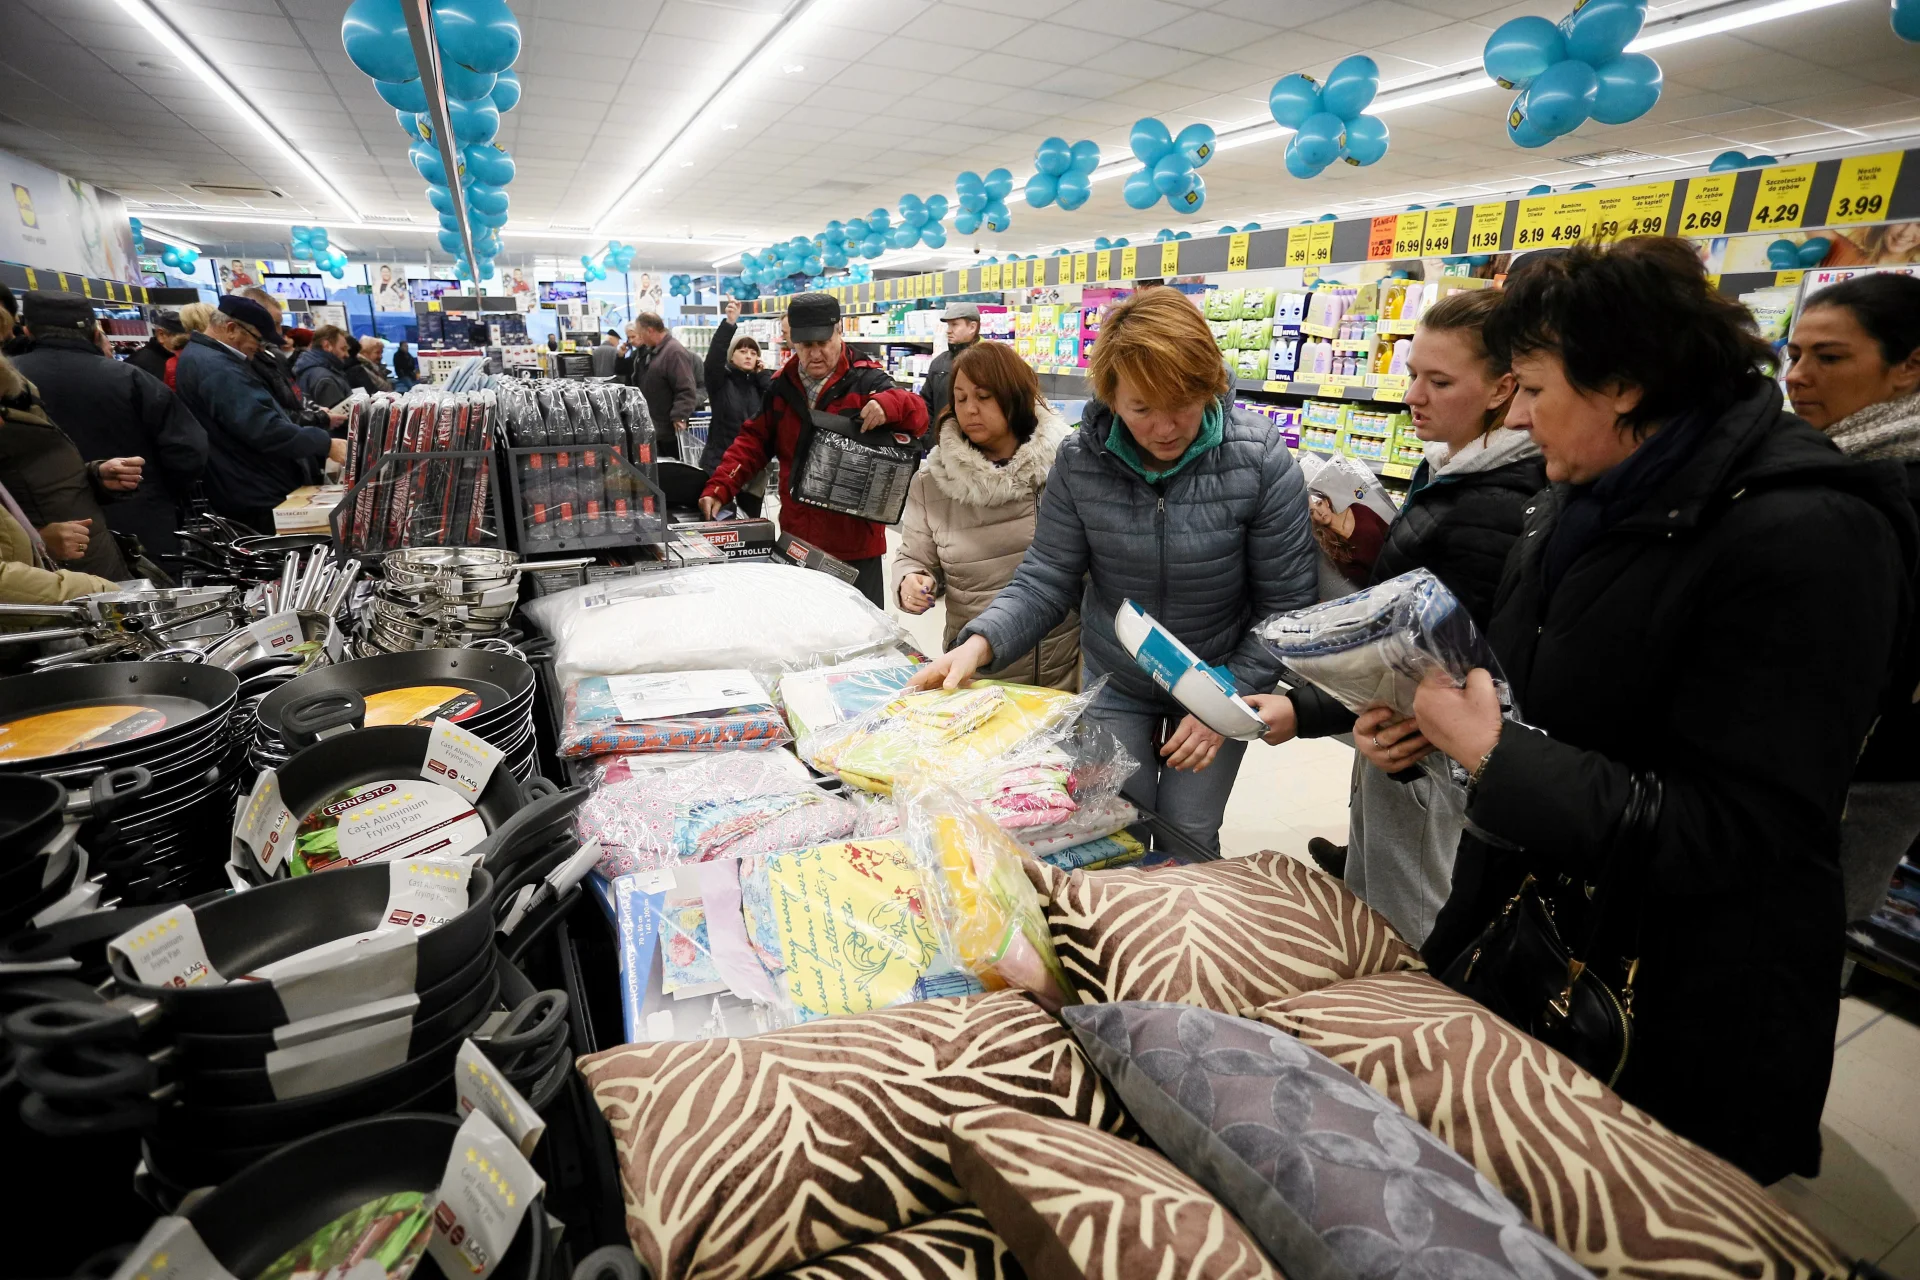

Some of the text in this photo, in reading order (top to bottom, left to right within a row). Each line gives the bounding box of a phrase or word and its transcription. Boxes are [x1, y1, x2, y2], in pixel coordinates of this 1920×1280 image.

[1765, 176, 1807, 186] Szczoteczka
[1756, 203, 1799, 224] 4.29
[1836, 195, 1883, 217] 3.99
[1627, 216, 1662, 234] 4.99
[1684, 210, 1722, 230] 2.69
[1472, 232, 1498, 247] 11.39
[1519, 227, 1545, 244] 8.19
[1551, 224, 1581, 241] 4.99
[1371, 245, 1391, 257] 12.29
[1395, 239, 1419, 253] 16.99
[1426, 237, 1449, 251] 9.49
[1230, 256, 1244, 266] 4.99
[1817, 271, 1854, 283] HiPP
[738, 547, 771, 556] TROLLEY
[441, 740, 453, 750] Cast
[327, 785, 394, 814] ERNESTO
[347, 799, 429, 836] Cast Aluminium
[367, 812, 422, 839] Frying Pan
[408, 878, 423, 888] Cast
[415, 890, 435, 901] Frying
[787, 937, 804, 974] long
[183, 961, 202, 977] ILAG
